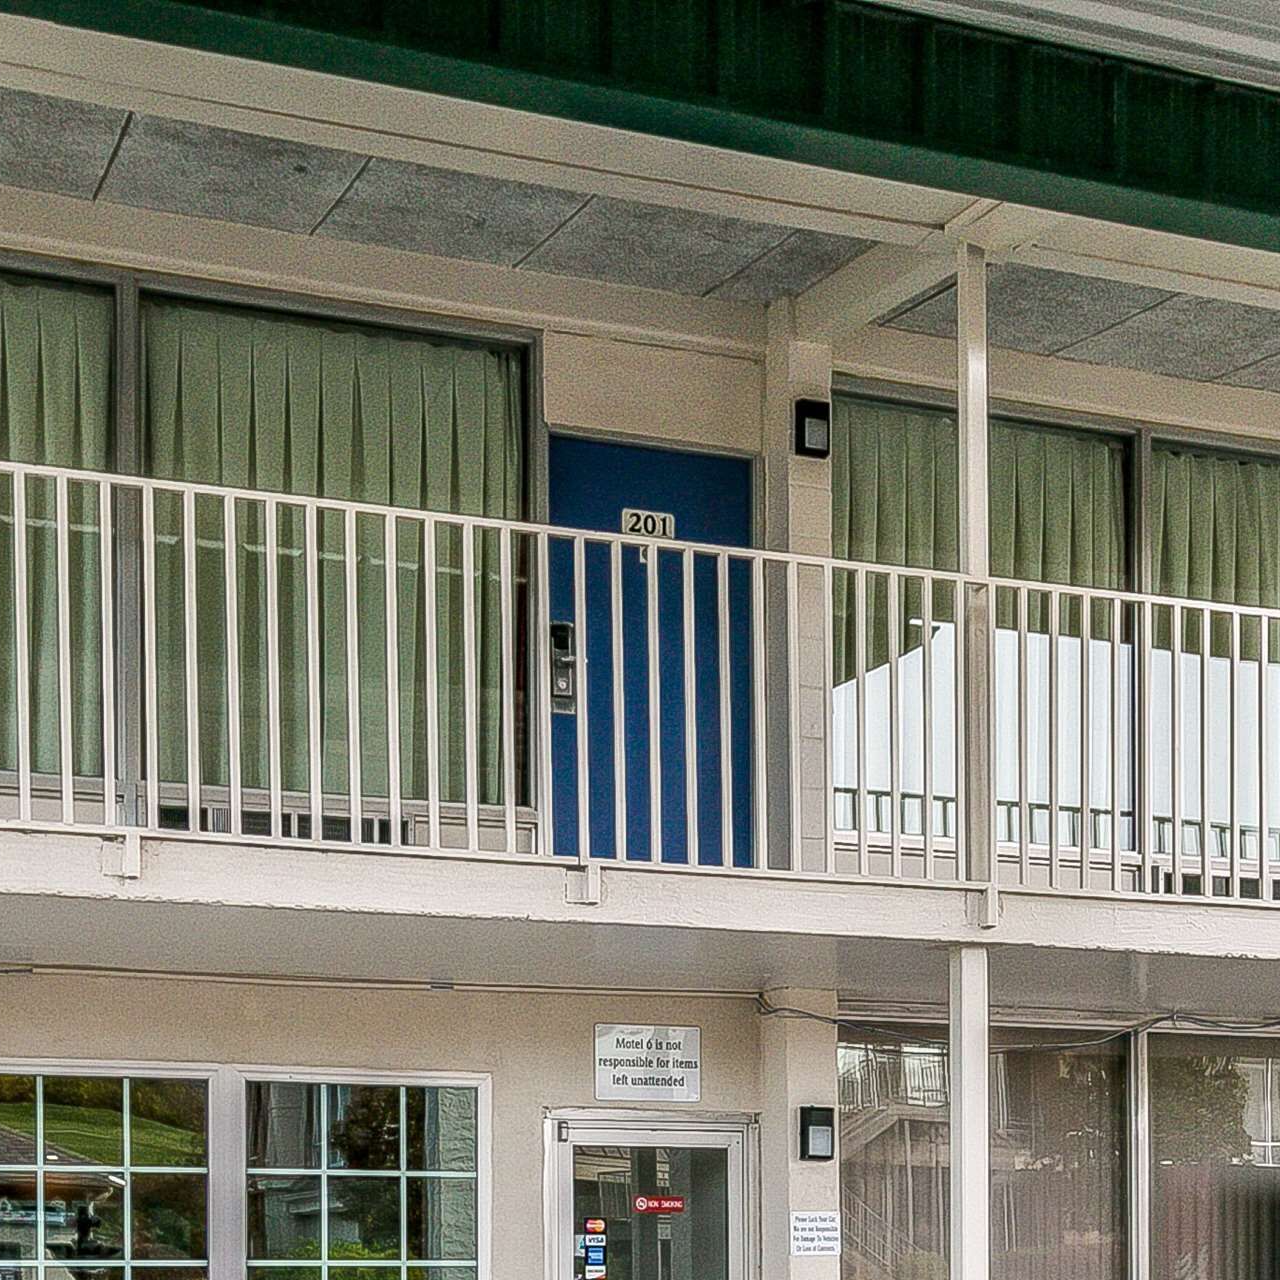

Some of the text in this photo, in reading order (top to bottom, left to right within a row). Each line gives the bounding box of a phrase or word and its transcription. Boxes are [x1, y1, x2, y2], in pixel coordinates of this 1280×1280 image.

[628, 512, 668, 537] 201
[615, 1037, 682, 1051] Motel 6 is not
[598, 1056, 698, 1070] responsible for items
[612, 1073, 685, 1088] left unattended
[588, 1236, 605, 1244] VISA
